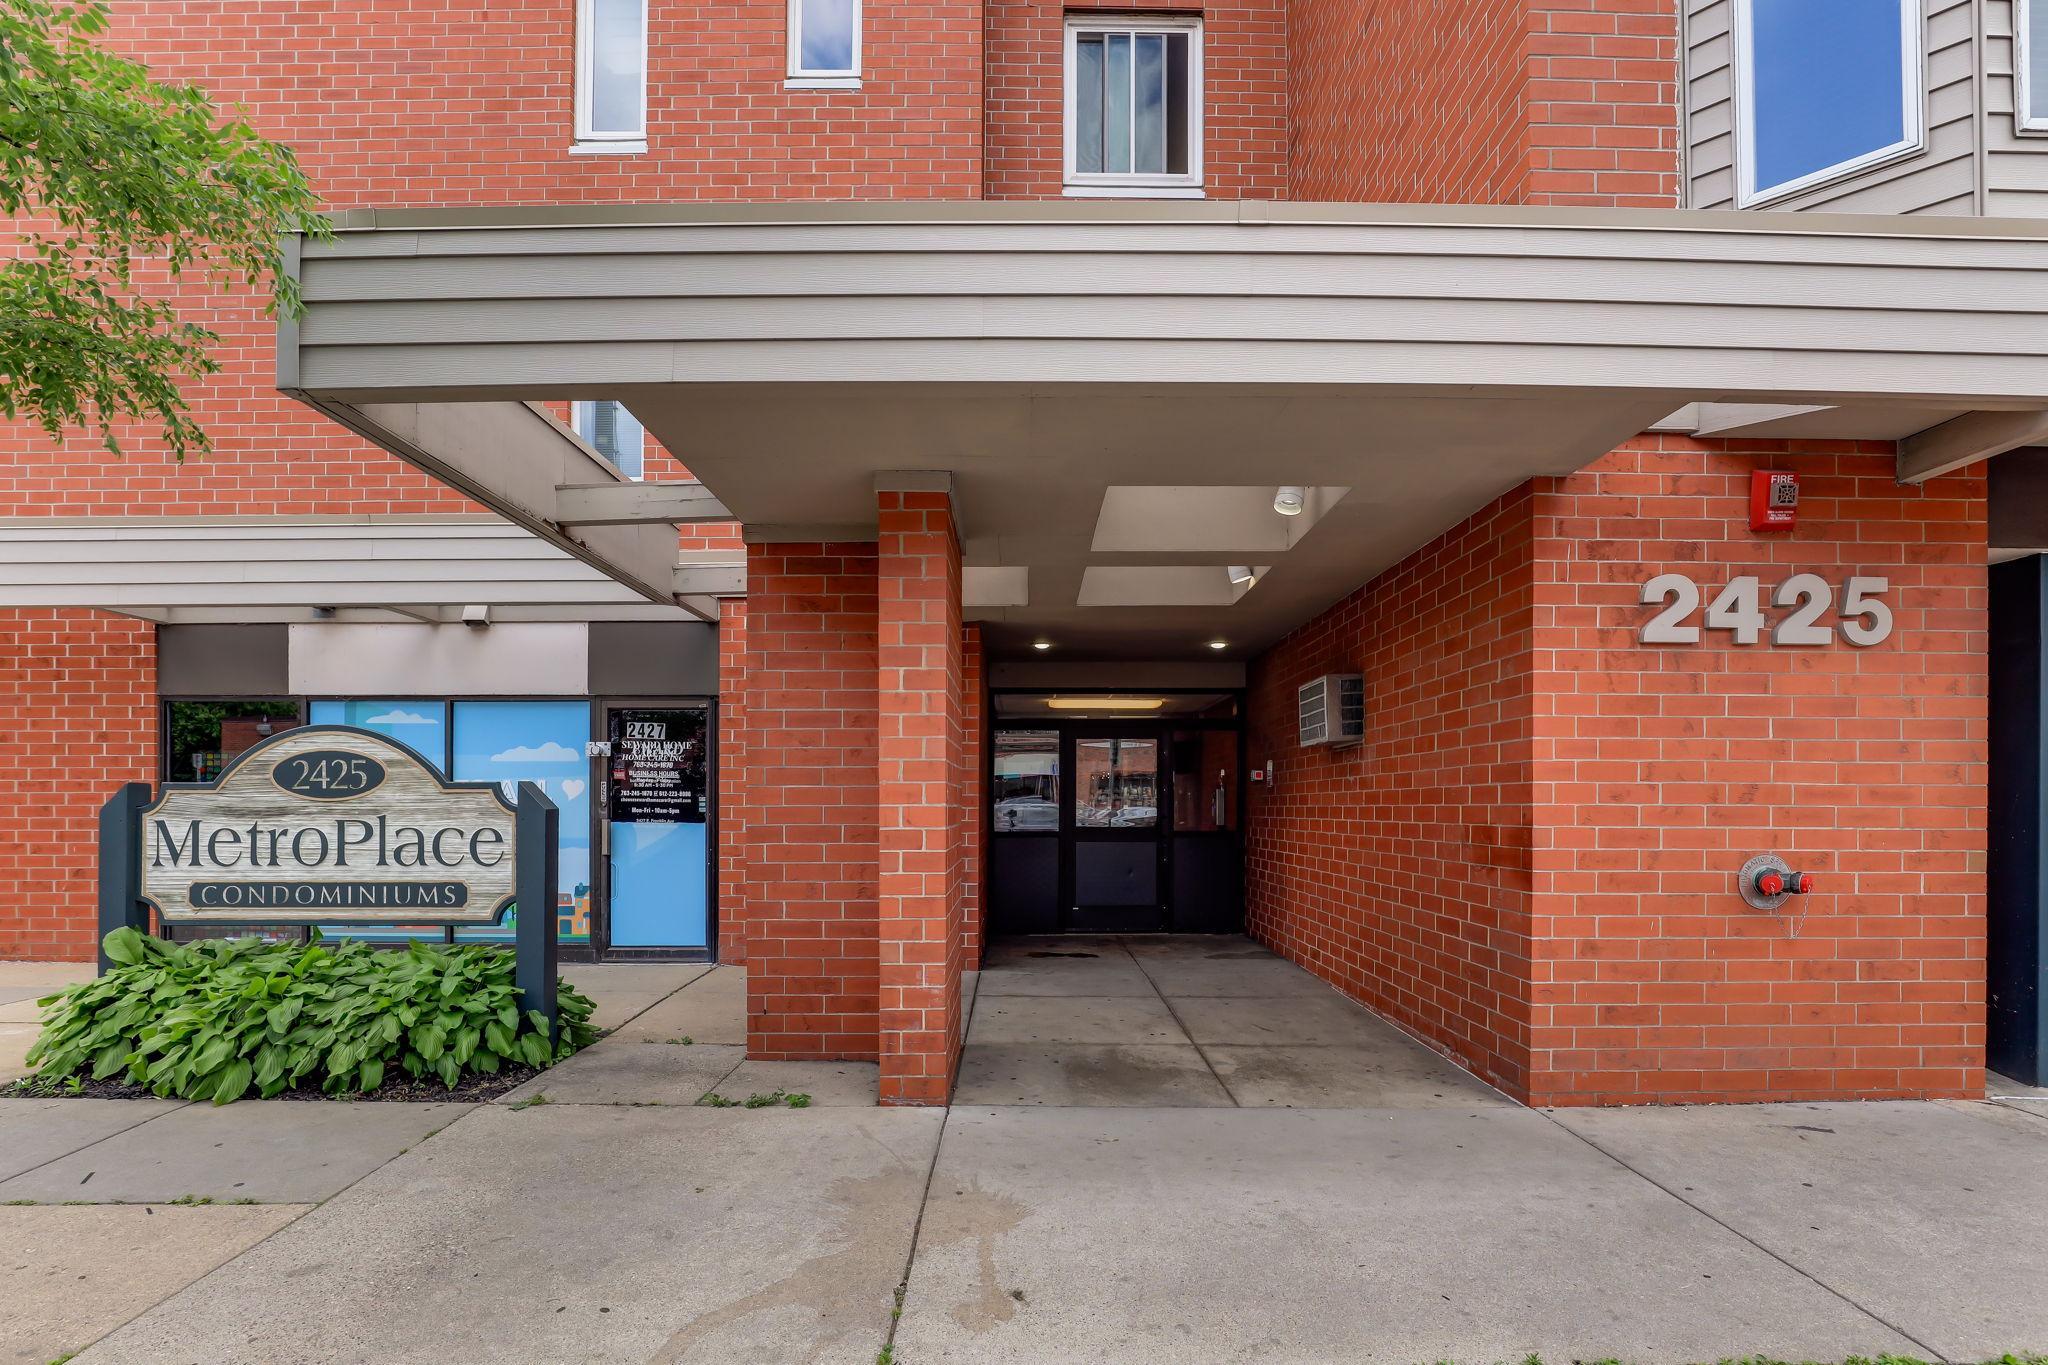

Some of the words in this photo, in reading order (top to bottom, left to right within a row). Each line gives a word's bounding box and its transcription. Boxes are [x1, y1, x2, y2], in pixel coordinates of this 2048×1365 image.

[1771, 474, 1794, 484] FIRE
[1640, 573, 1893, 646] 2425
[628, 723, 664, 739] 2427
[663, 741, 693, 750] HOME
[291, 759, 368, 791] 2425
[152, 815, 505, 868] MetroPlace
[200, 884, 457, 905] CONDOMINIUMS
